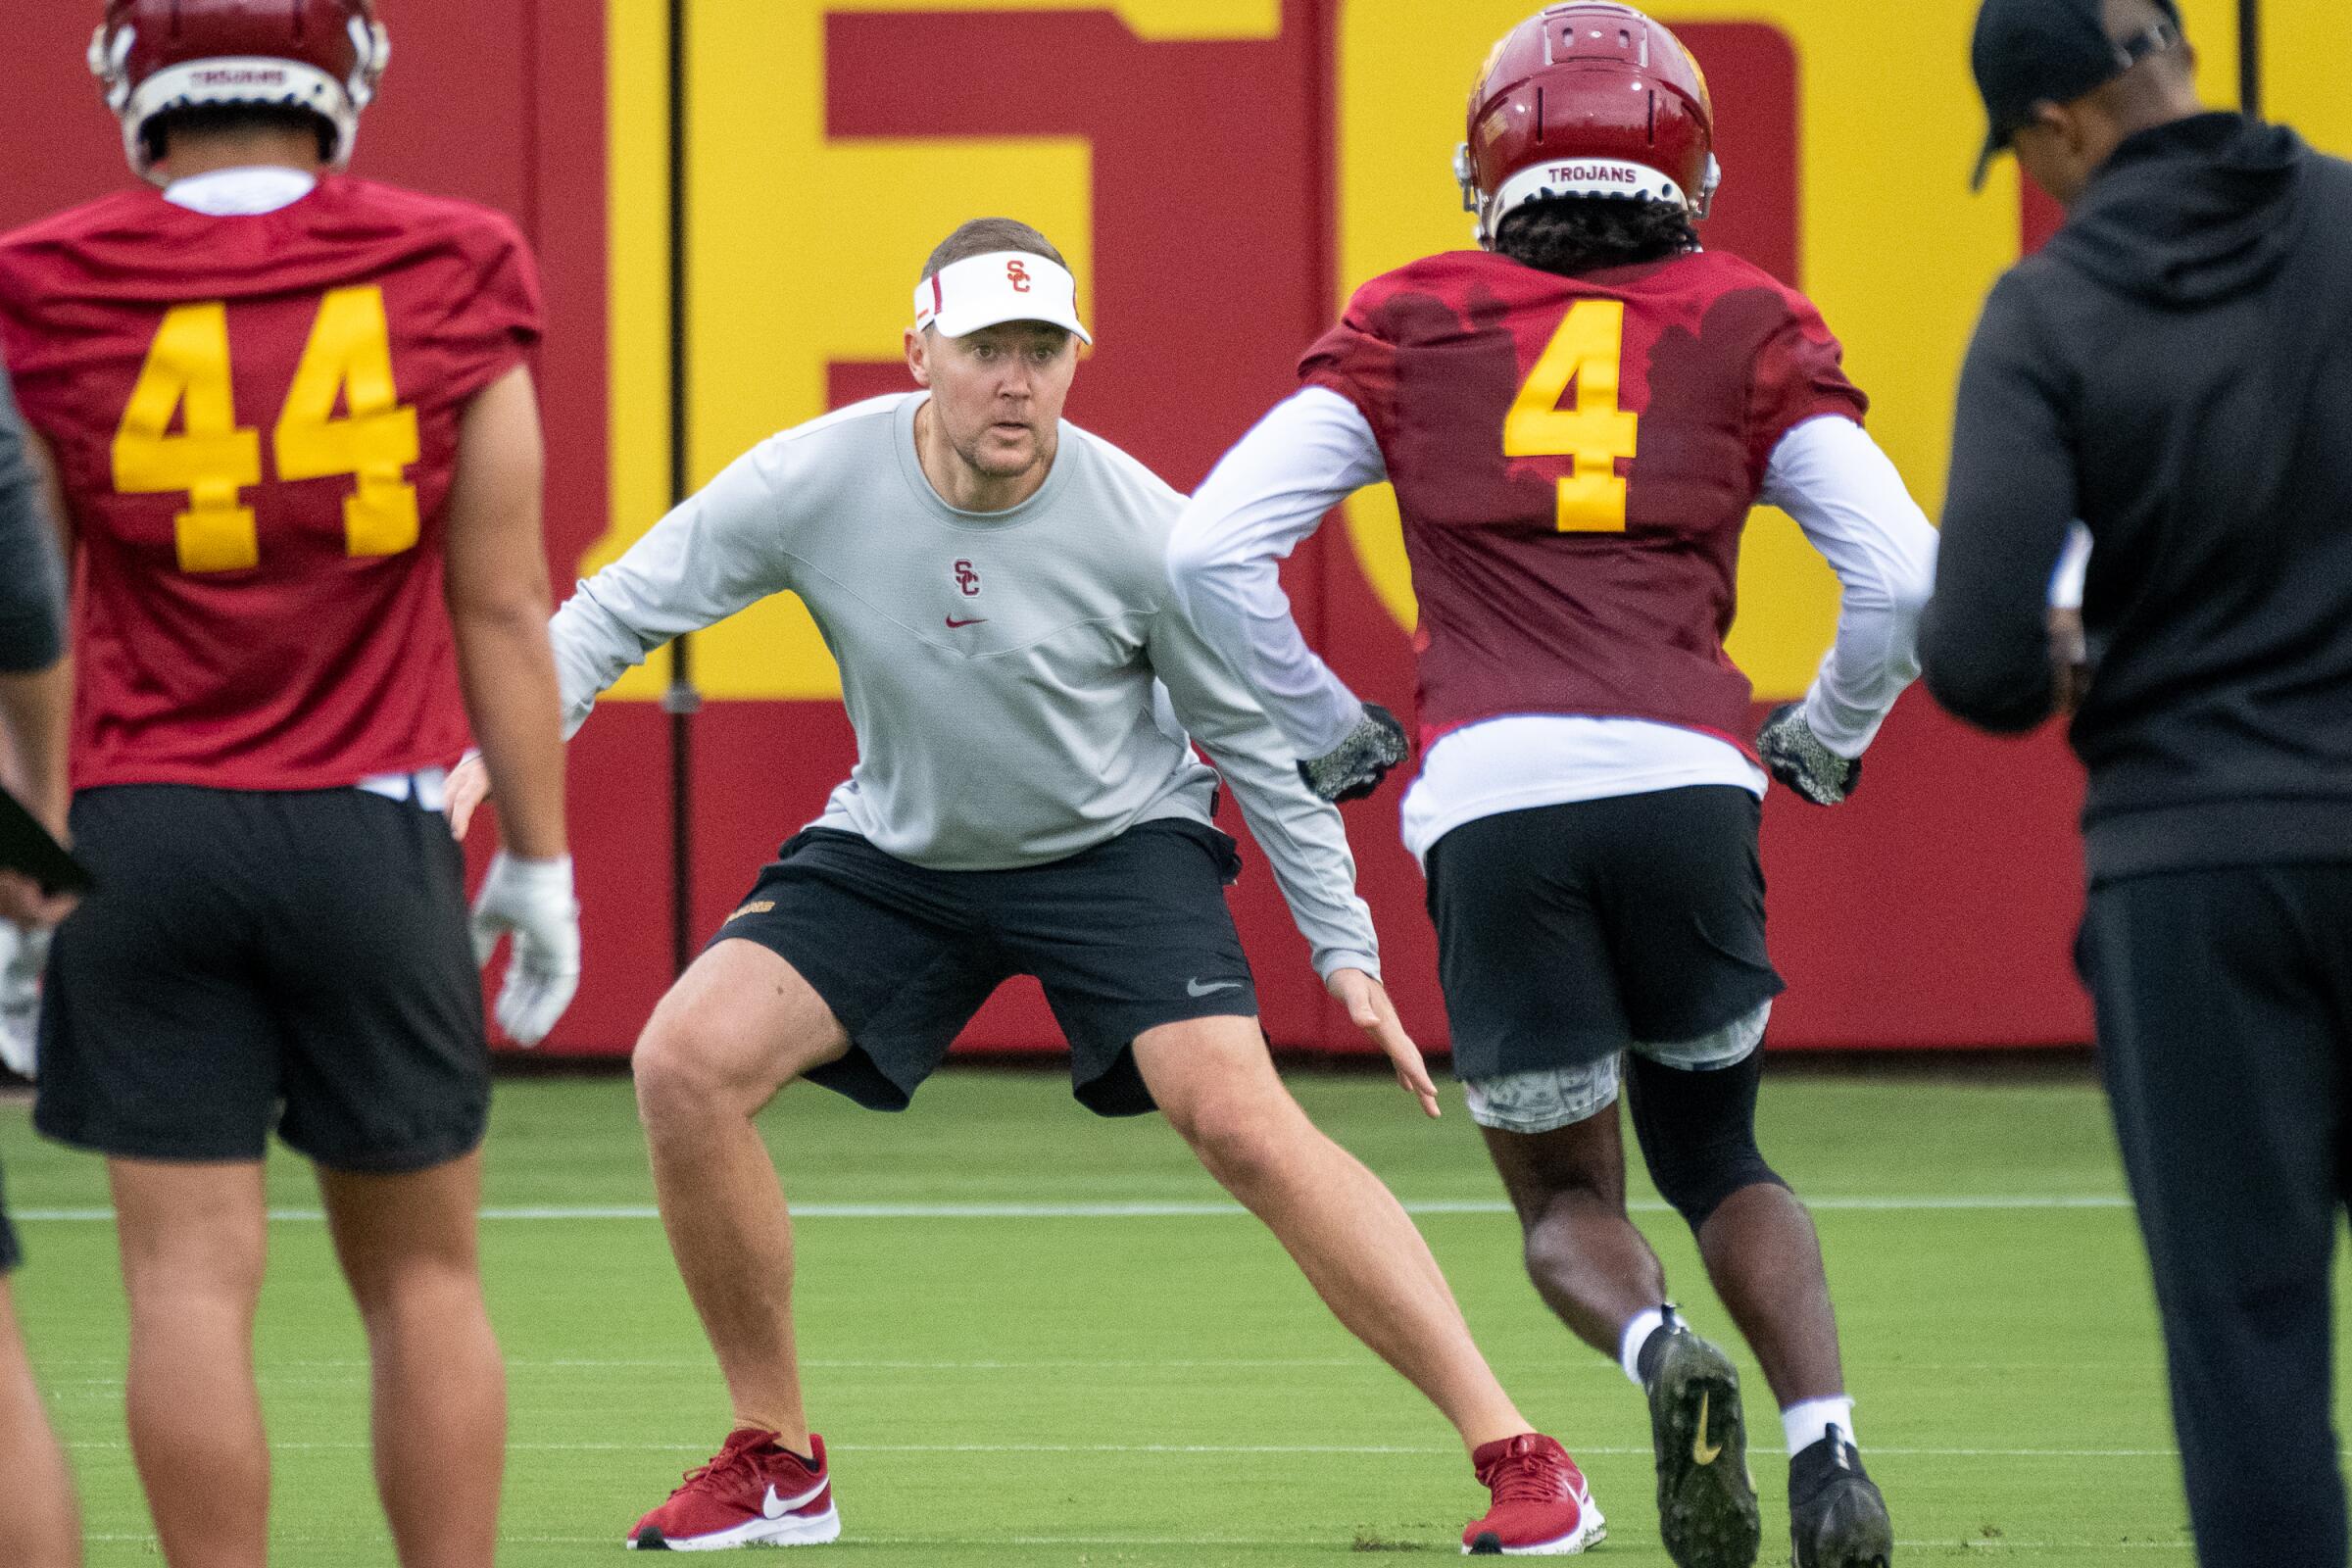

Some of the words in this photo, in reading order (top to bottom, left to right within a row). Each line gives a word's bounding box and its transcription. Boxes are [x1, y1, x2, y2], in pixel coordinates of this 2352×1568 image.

[1548, 166, 1637, 184] TROJANS
[1006, 260, 1031, 293] SC
[111, 284, 419, 572] 44
[1503, 299, 1638, 532] 4
[954, 559, 980, 597] SC
